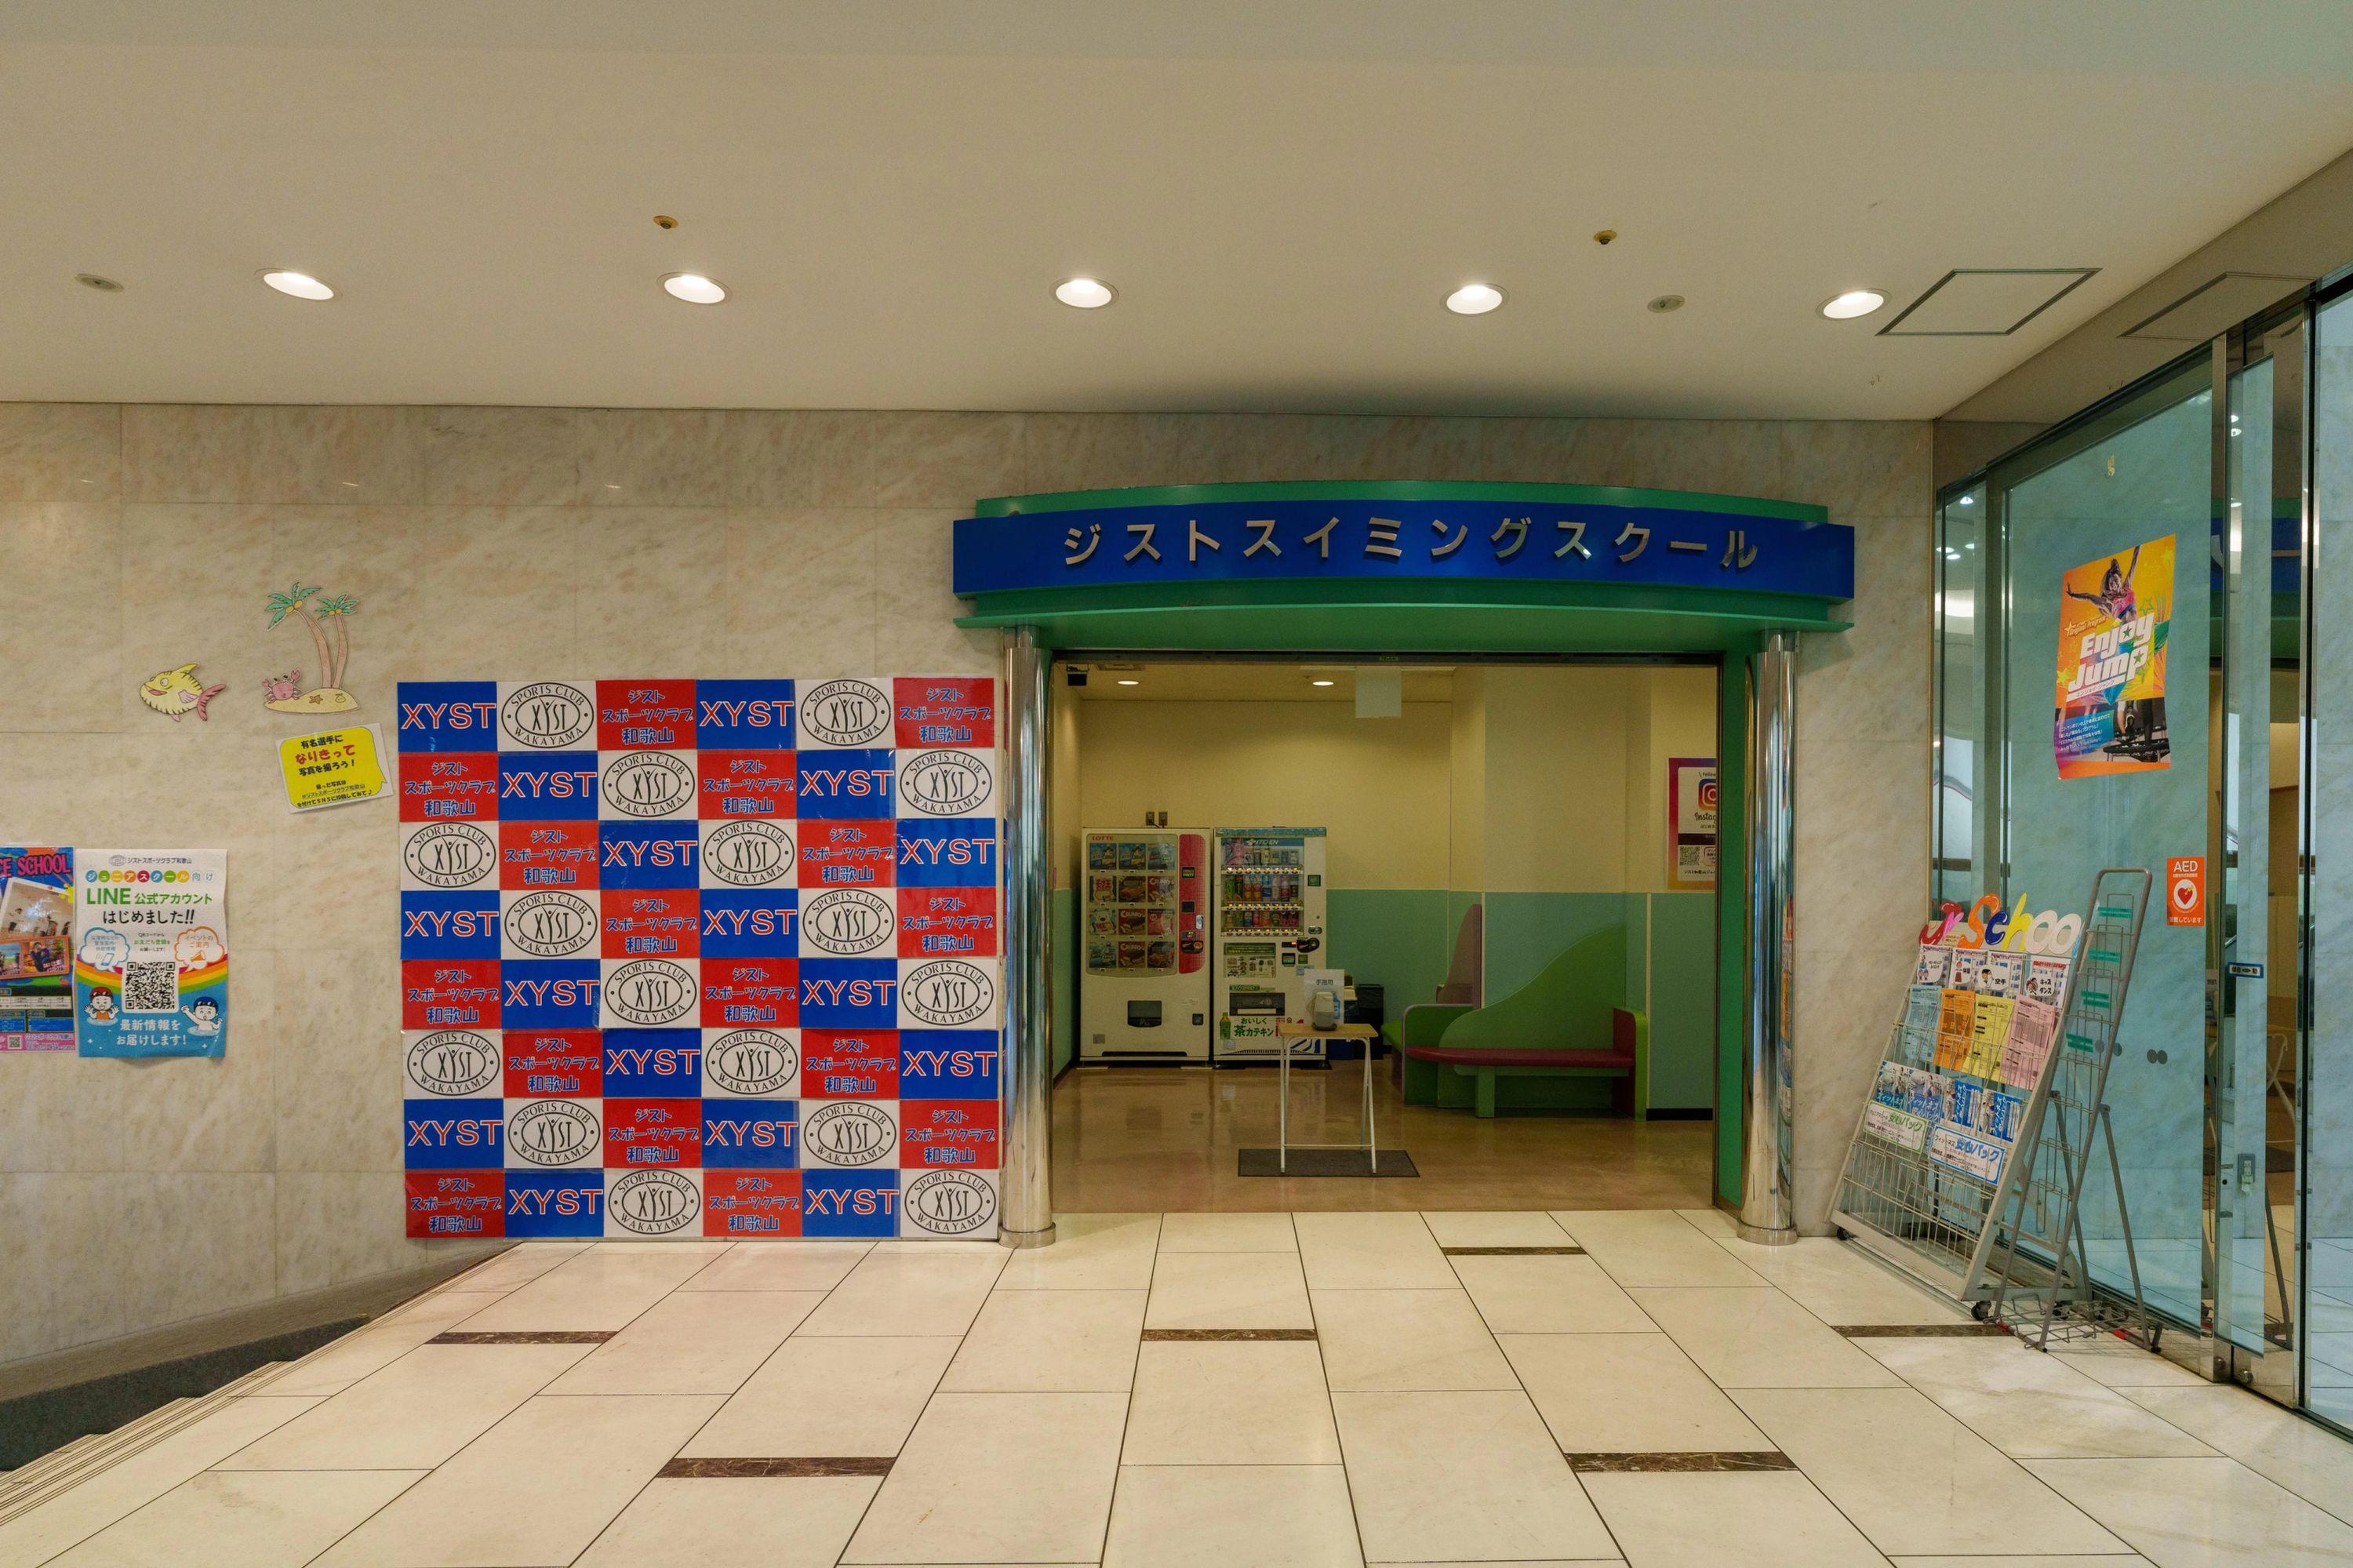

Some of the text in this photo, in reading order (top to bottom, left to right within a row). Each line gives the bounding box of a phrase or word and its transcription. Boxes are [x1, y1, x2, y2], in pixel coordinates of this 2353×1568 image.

[1064, 517, 1757, 568] ジストスイミングスクール
[2080, 613, 2155, 660] Enjoy
[2068, 645, 2149, 692] Jump
[511, 686, 584, 707] SPORTS CLUB
[629, 689, 666, 703] ジスト
[927, 687, 964, 701] ジスト
[402, 703, 496, 729] XYST
[532, 697, 566, 736] XYST
[602, 708, 693, 722] スポーツクラブ
[700, 700, 795, 726] XYST
[831, 695, 864, 733] XYST
[900, 707, 991, 720] スポーツクラブ
[301, 734, 344, 749] 有名選手に
[515, 726, 583, 745] WAKAYAMA
[621, 727, 674, 744] 和歌山
[919, 726, 972, 742] 和歌山
[295, 744, 355, 765] なりきって
[431, 762, 468, 775] ジスト
[730, 759, 767, 773] ジスト
[909, 753, 983, 774] SPORTS CLUB
[405, 780, 495, 795] スポーツクラブ
[502, 771, 598, 798] XYST
[633, 766, 667, 805] XYST
[704, 778, 794, 792] スポーツクラブ
[800, 769, 894, 795] XYST
[930, 764, 965, 803] XYST
[424, 799, 476, 816] 和歌山
[723, 797, 775, 813] 和歌山
[913, 794, 981, 813] WAKAYAMA
[531, 830, 568, 843] ジスト
[830, 828, 867, 842] ジスト
[435, 836, 469, 875] XYST
[504, 849, 595, 862] スポーツクラブ
[603, 840, 698, 866] XYST
[733, 835, 766, 873] XYST
[802, 847, 894, 860] スポーツクラブ
[900, 839, 995, 864] XYST
[16, 853, 72, 876] SCHOOL
[2173, 860, 2198, 872] AED
[86, 871, 214, 882] ジュニアスクール向け
[523, 868, 576, 884] 和歌山
[822, 866, 875, 882] 和歌山
[86, 888, 213, 904] LINE 公式アカウント
[514, 894, 587, 915] SPORTS CLUB
[929, 897, 966, 910] ジスト
[633, 898, 670, 912] ジスト
[405, 911, 499, 937] XYST
[535, 905, 569, 944] XYST
[606, 918, 696, 931] スポーツクラブ
[704, 909, 798, 935] XYST
[832, 904, 866, 942] XYST
[903, 915, 993, 930] スポーツクラブ
[518, 935, 586, 954] WAKAYAMA
[625, 937, 678, 953] 和歌山
[922, 934, 974, 951] 和歌山
[435, 970, 471, 983] ジスト
[732, 967, 769, 980] ジスト
[911, 962, 984, 984] SPORTS CLUB
[407, 988, 499, 1002] スポーツクラブ
[504, 980, 600, 1006] XYST
[635, 973, 668, 1012] XYST
[705, 986, 795, 1000] スポーツクラブ
[802, 980, 896, 1006] XYST
[932, 975, 966, 1013] XYST
[427, 1007, 479, 1024] 和歌山
[725, 1005, 776, 1021] 和歌山
[915, 1004, 983, 1023] WAKAYAMA
[120, 1020, 181, 1031] 最新情報を
[1234, 1025, 1274, 1037] 茶カテキン
[535, 1038, 572, 1051] ジスト
[832, 1039, 869, 1052] ジスト
[438, 1045, 472, 1083] XYST
[508, 1057, 598, 1071] スポーツクラブ
[606, 1049, 701, 1075] XYST
[736, 1043, 770, 1082] XYST
[806, 1057, 896, 1071] スポーツクラブ
[903, 1050, 998, 1076] XYST
[528, 1075, 580, 1092] 和歌山
[825, 1076, 877, 1093] 和歌山
[516, 1103, 590, 1124] SPORTS CLUB
[635, 1108, 671, 1122] ジスト
[932, 1109, 969, 1122] ジスト
[1888, 1112, 1922, 1132] 安心パック
[408, 1119, 504, 1146] XYST
[537, 1114, 571, 1153] XYST
[608, 1127, 698, 1141] スポーツクラブ
[705, 1121, 798, 1147] XYST
[835, 1115, 867, 1154] XYST
[905, 1128, 995, 1142] スポーツクラブ
[520, 1144, 588, 1162] WAKAYAMA
[627, 1146, 679, 1162] 和歌山
[925, 1147, 976, 1163] 和歌山
[1955, 1138, 1999, 1162] 安心パック
[438, 1177, 475, 1191] ジスト
[736, 1177, 773, 1190] ジスト
[914, 1173, 987, 1193] SPORTS CLUB
[410, 1197, 502, 1210] スポーツクラブ
[508, 1188, 604, 1215] XYST
[638, 1183, 671, 1222] XYST
[709, 1195, 799, 1210] スポーツクラブ
[806, 1188, 900, 1214] XYST
[935, 1184, 968, 1222] XYST
[430, 1216, 482, 1232] 和歌山
[729, 1214, 780, 1231] 和歌山
[918, 1213, 984, 1231] WAKAYAMA
